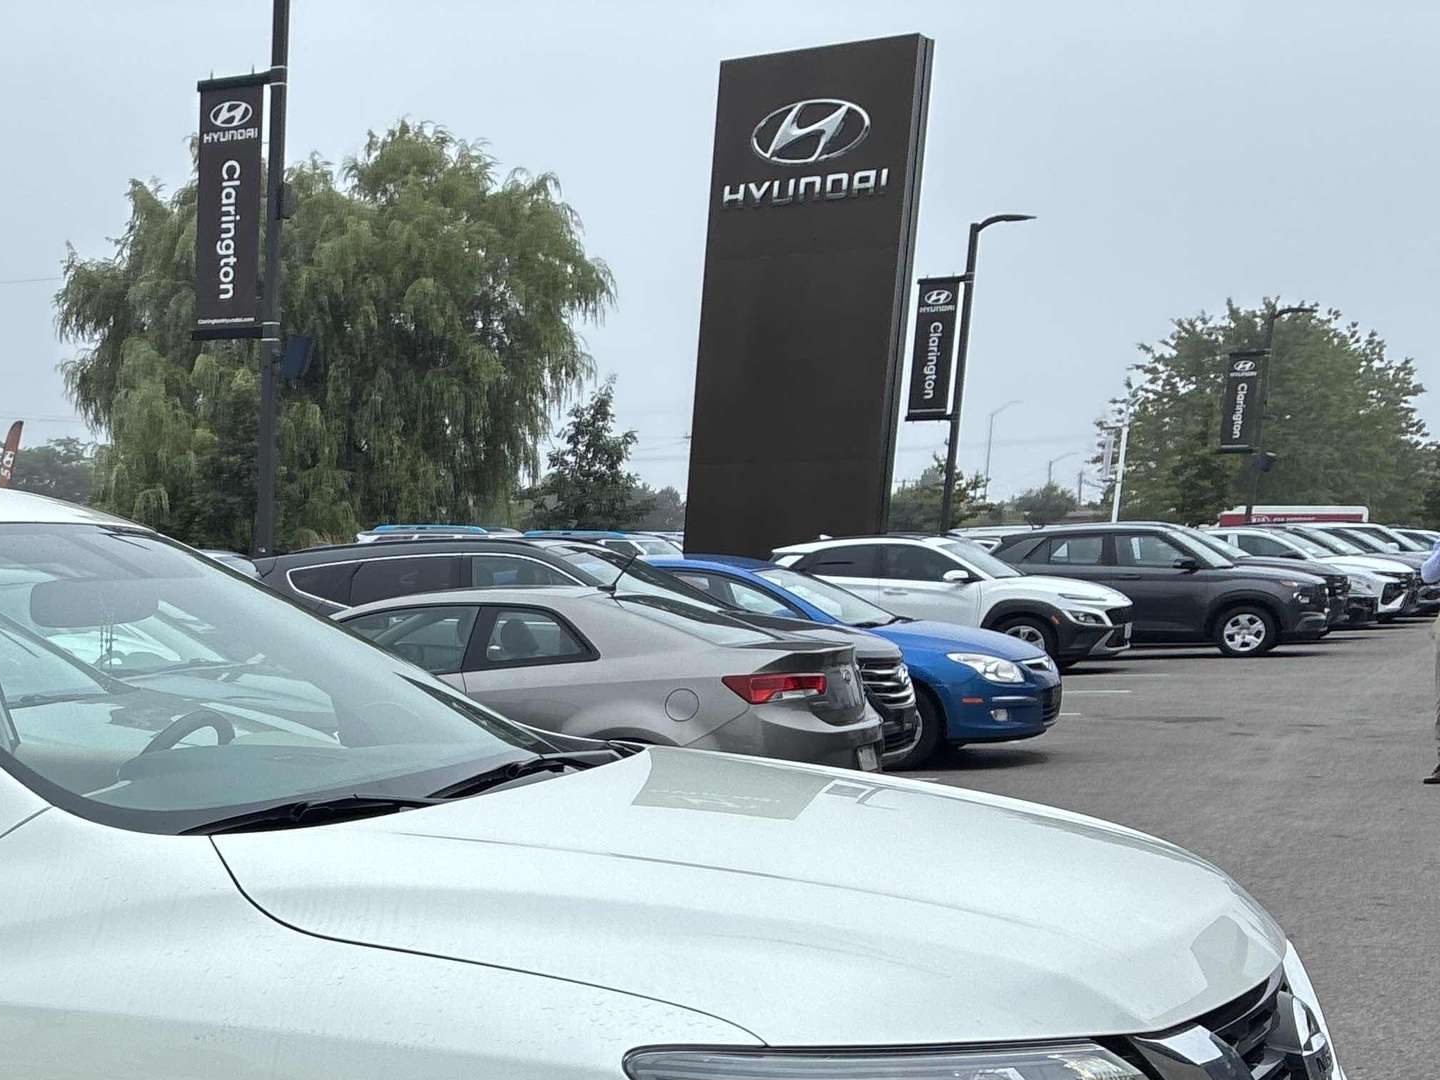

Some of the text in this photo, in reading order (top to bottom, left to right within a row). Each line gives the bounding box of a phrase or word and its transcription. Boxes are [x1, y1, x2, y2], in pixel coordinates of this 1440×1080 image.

[203, 128, 258, 143] HYUNDAI
[722, 168, 889, 207] HYUNDAI
[216, 160, 241, 300] Clarington
[923, 321, 943, 399] Clarington
[1231, 383, 1248, 439] Clarington
